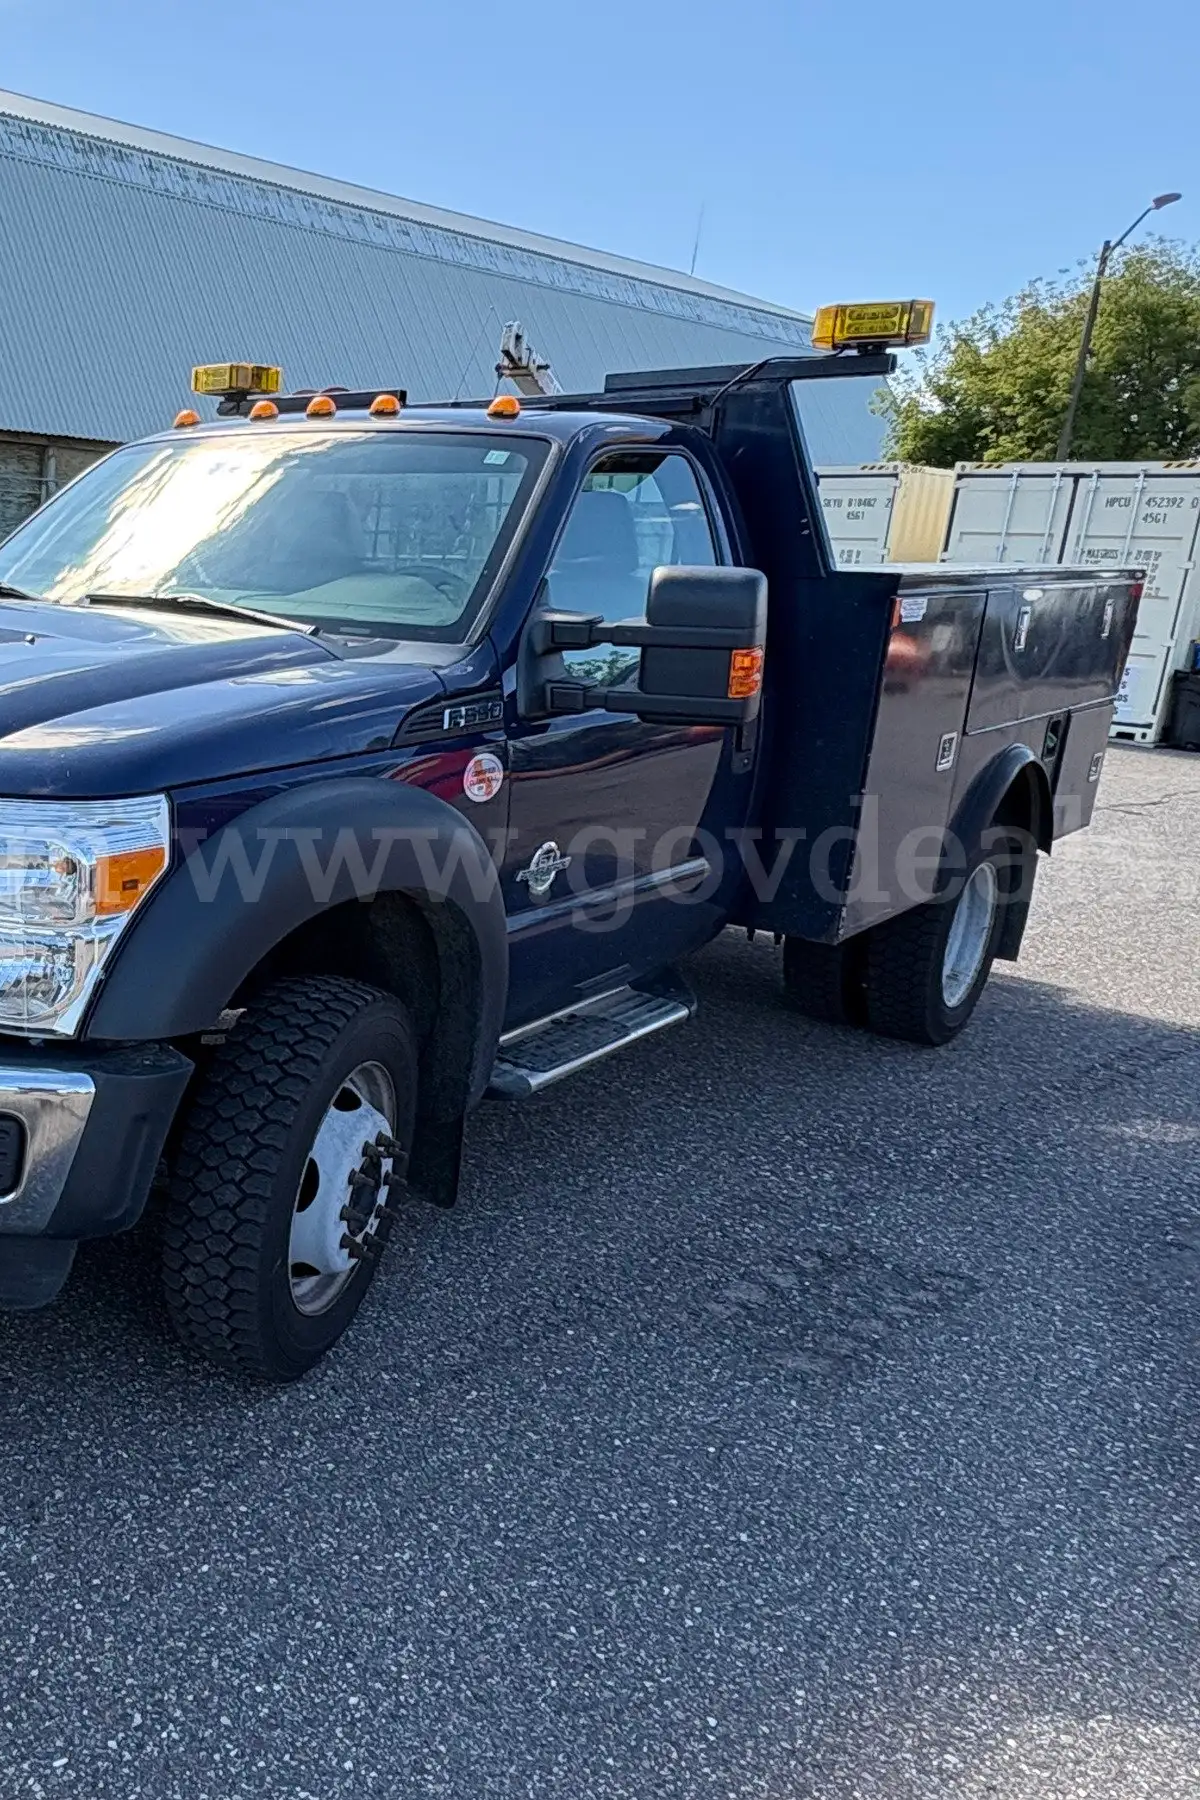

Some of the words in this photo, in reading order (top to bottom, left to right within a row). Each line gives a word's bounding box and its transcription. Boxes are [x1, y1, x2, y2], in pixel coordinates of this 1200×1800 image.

[1104, 497, 1132, 508] HPCU
[1145, 497, 1185, 509] 452392
[1142, 513, 1168, 524] 45G1
